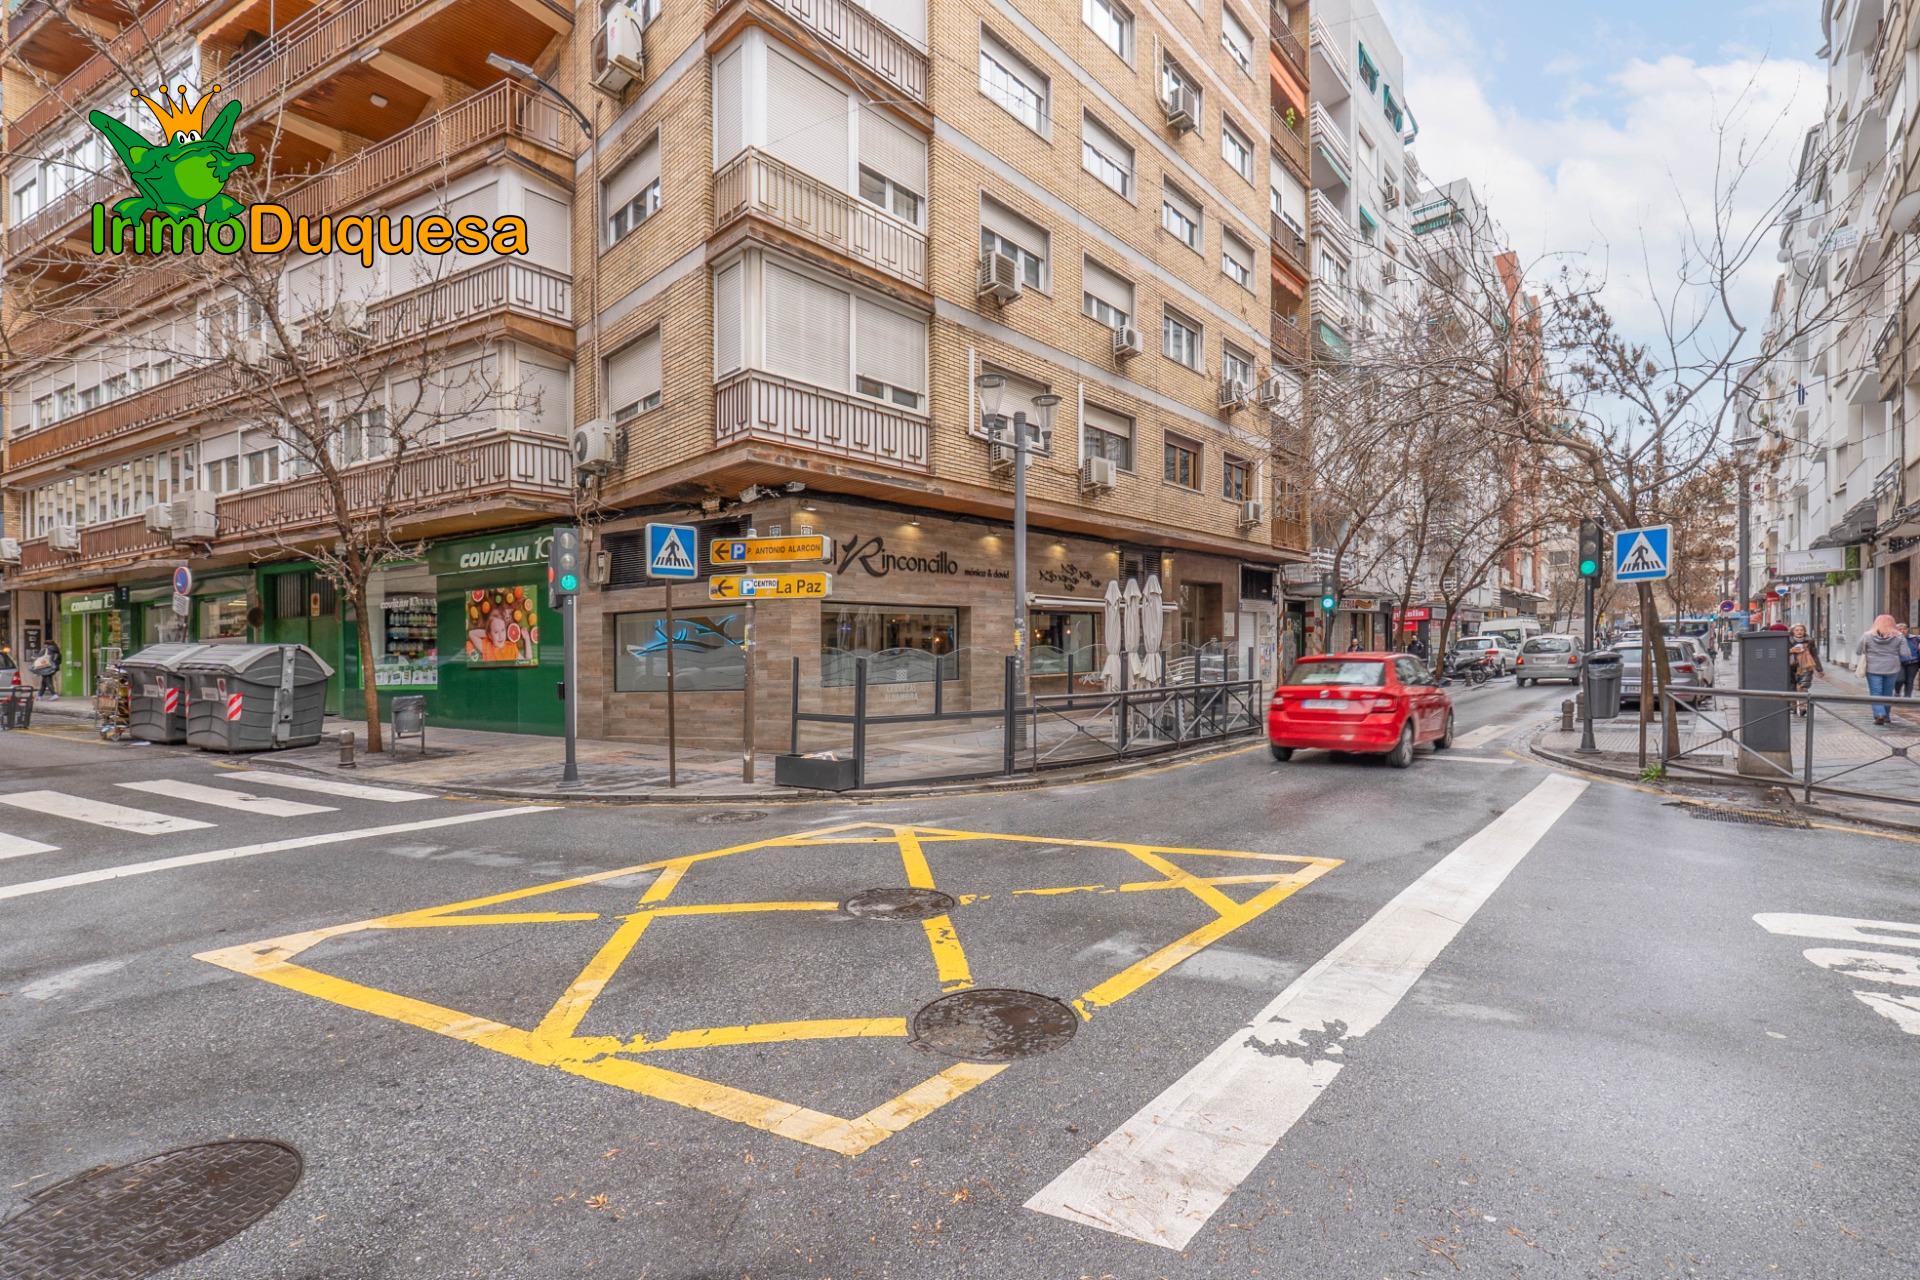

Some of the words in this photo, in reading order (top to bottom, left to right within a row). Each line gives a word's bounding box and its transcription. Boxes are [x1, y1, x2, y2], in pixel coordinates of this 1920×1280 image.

[460, 543, 529, 569] COVIRAN
[755, 546, 786, 554] ANTONIO
[837, 534, 958, 578] Rinconcillo
[776, 580, 792, 594] La
[797, 579, 821, 594] Paz
